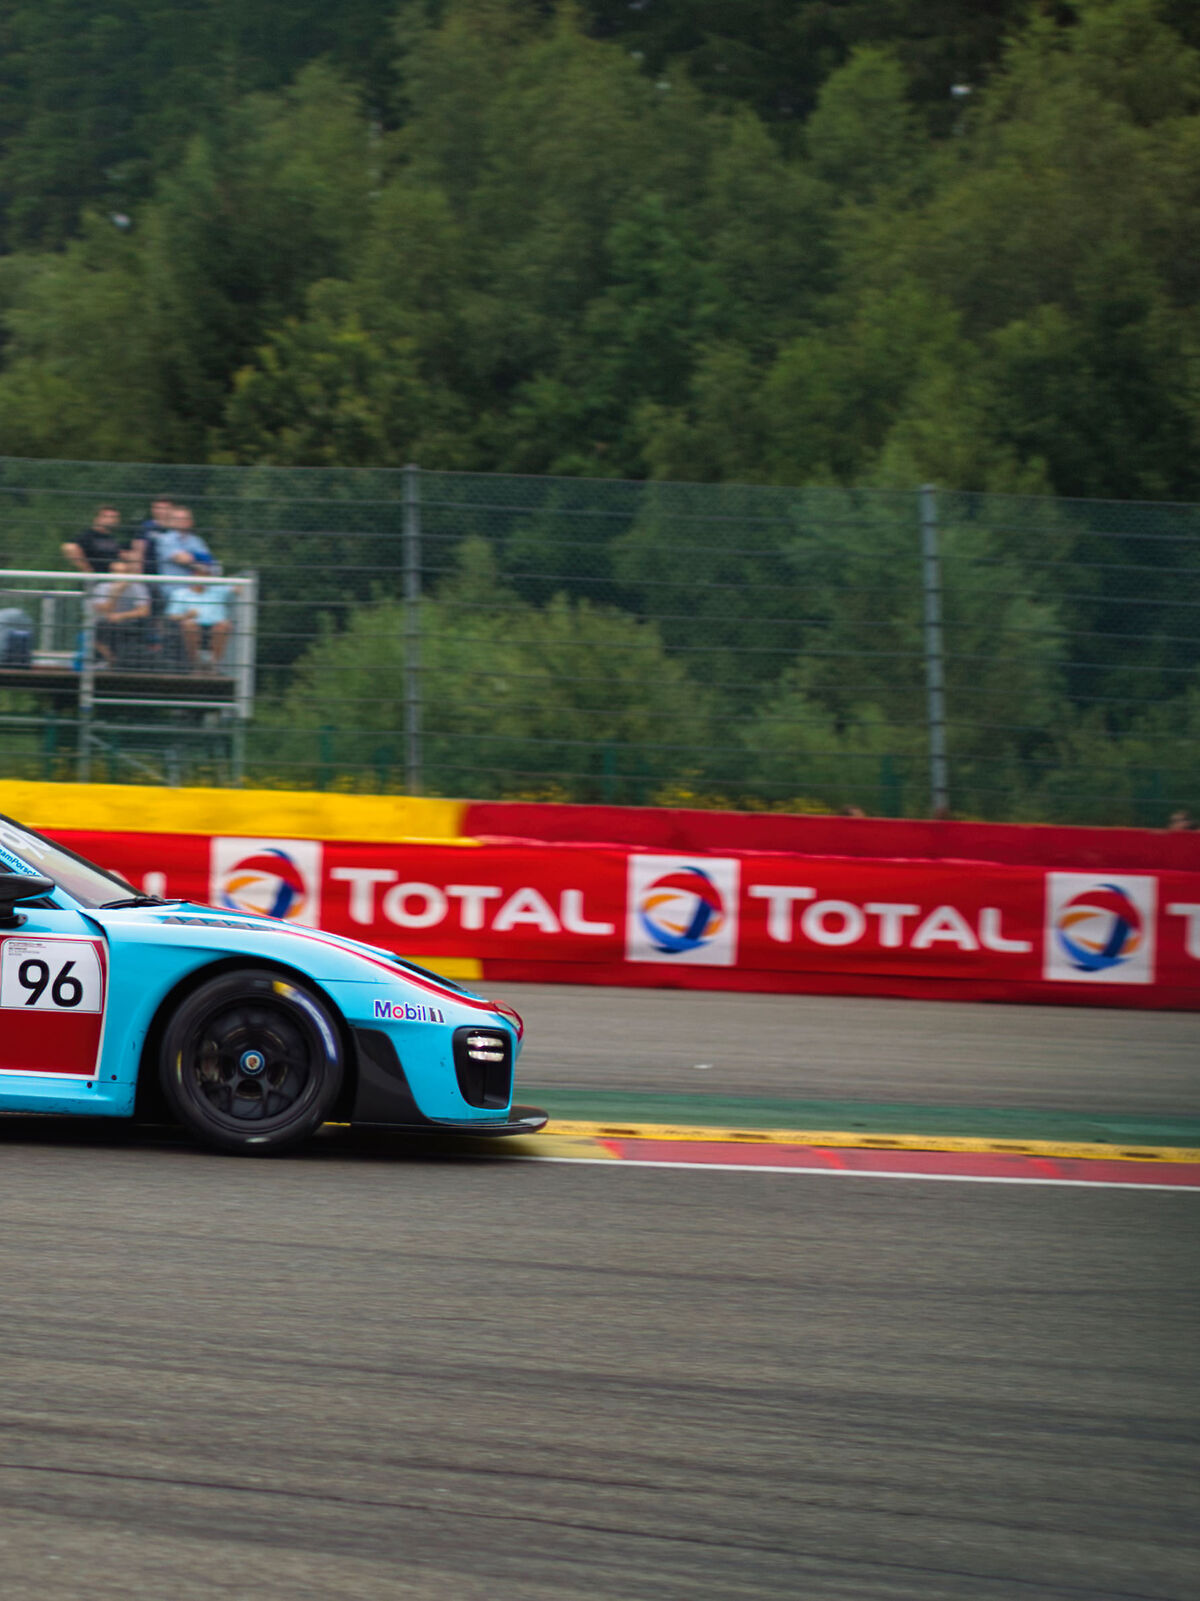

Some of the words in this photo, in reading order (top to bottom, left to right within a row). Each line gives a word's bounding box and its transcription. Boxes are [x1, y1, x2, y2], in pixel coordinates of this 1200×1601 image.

[330, 867, 615, 936] TOTAL
[747, 884, 1032, 953] TOTAL
[18, 959, 84, 1008] 96
[374, 1000, 427, 1021] Mobil
